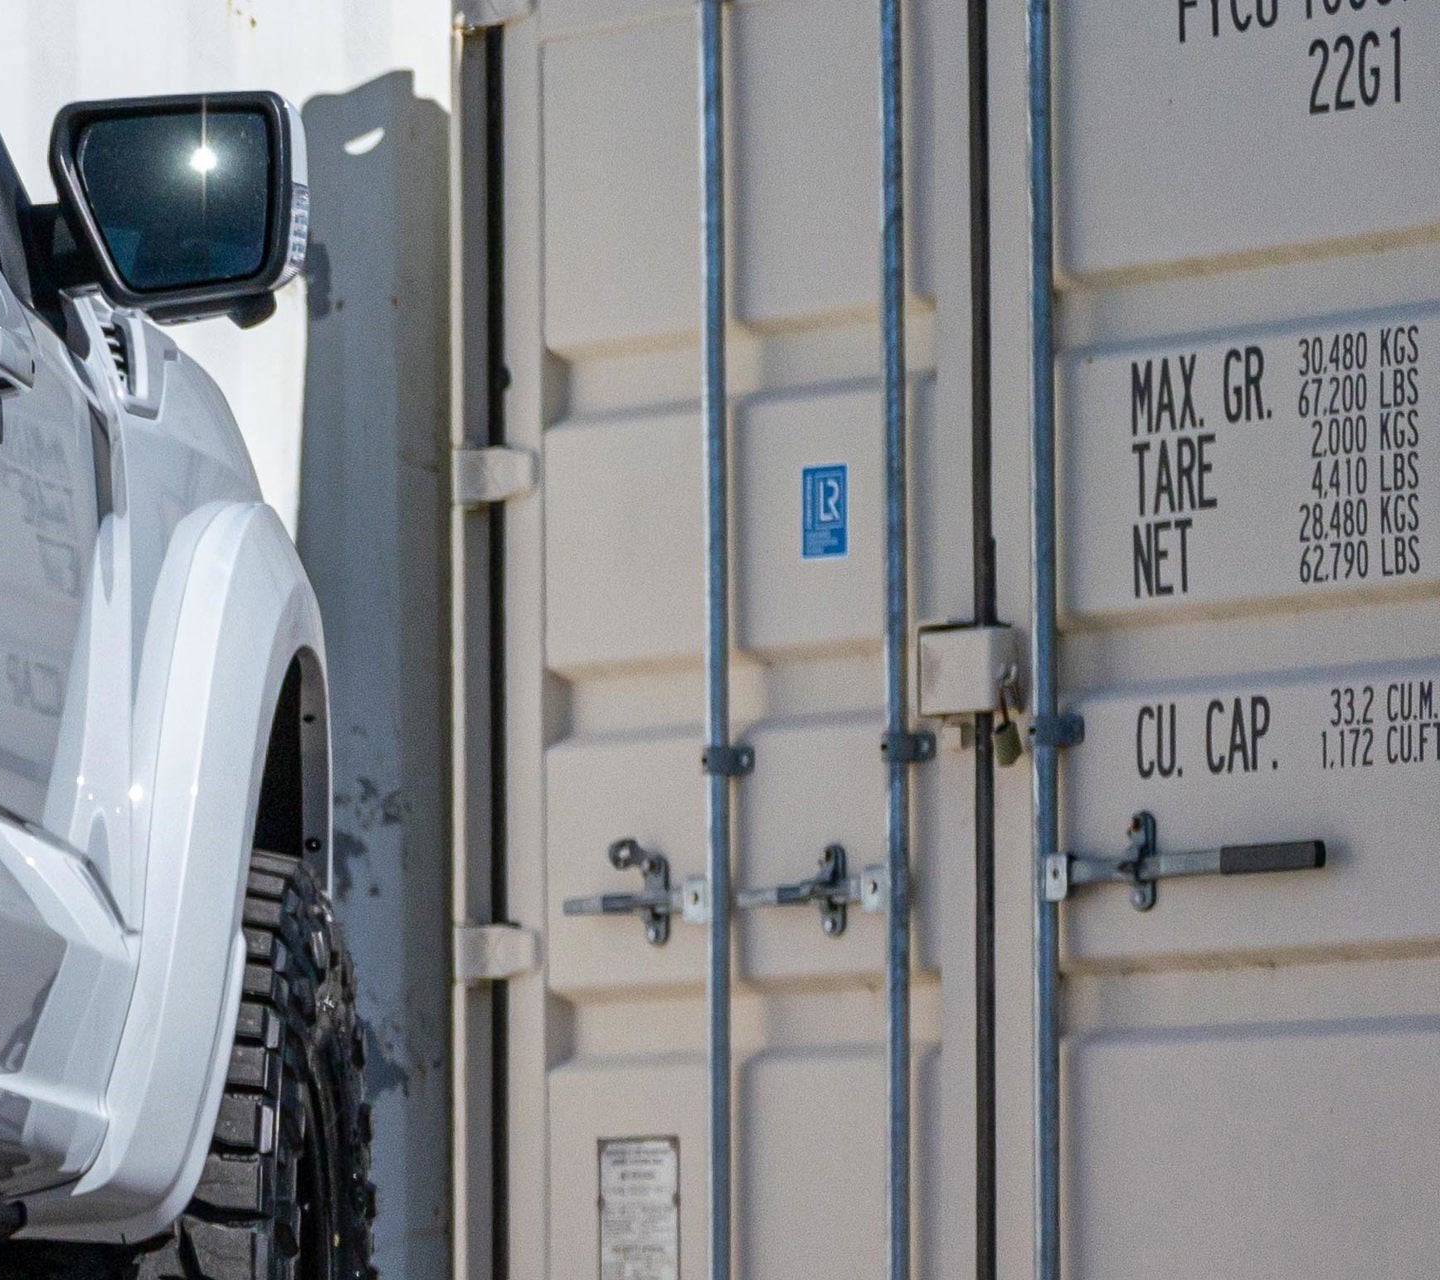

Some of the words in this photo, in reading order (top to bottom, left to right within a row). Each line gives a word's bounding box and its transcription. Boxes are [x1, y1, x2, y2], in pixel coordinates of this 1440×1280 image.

[1308, 26, 1401, 115] 22G1
[1380, 325, 1419, 368] KGS
[1132, 353, 1205, 436] MAX.
[1223, 345, 1272, 423] GR.
[1380, 367, 1419, 409] LBS
[1380, 409, 1419, 451] KGS
[1132, 433, 1217, 516] TARE
[1380, 451, 1419, 492] LBS
[1380, 493, 1419, 534] KGS
[1133, 518, 1193, 599] NET
[1381, 535, 1420, 576] LBS
[1330, 686, 1374, 726] 33.2
[1136, 703, 1183, 779] CU.
[1205, 695, 1278, 774] CAP.
